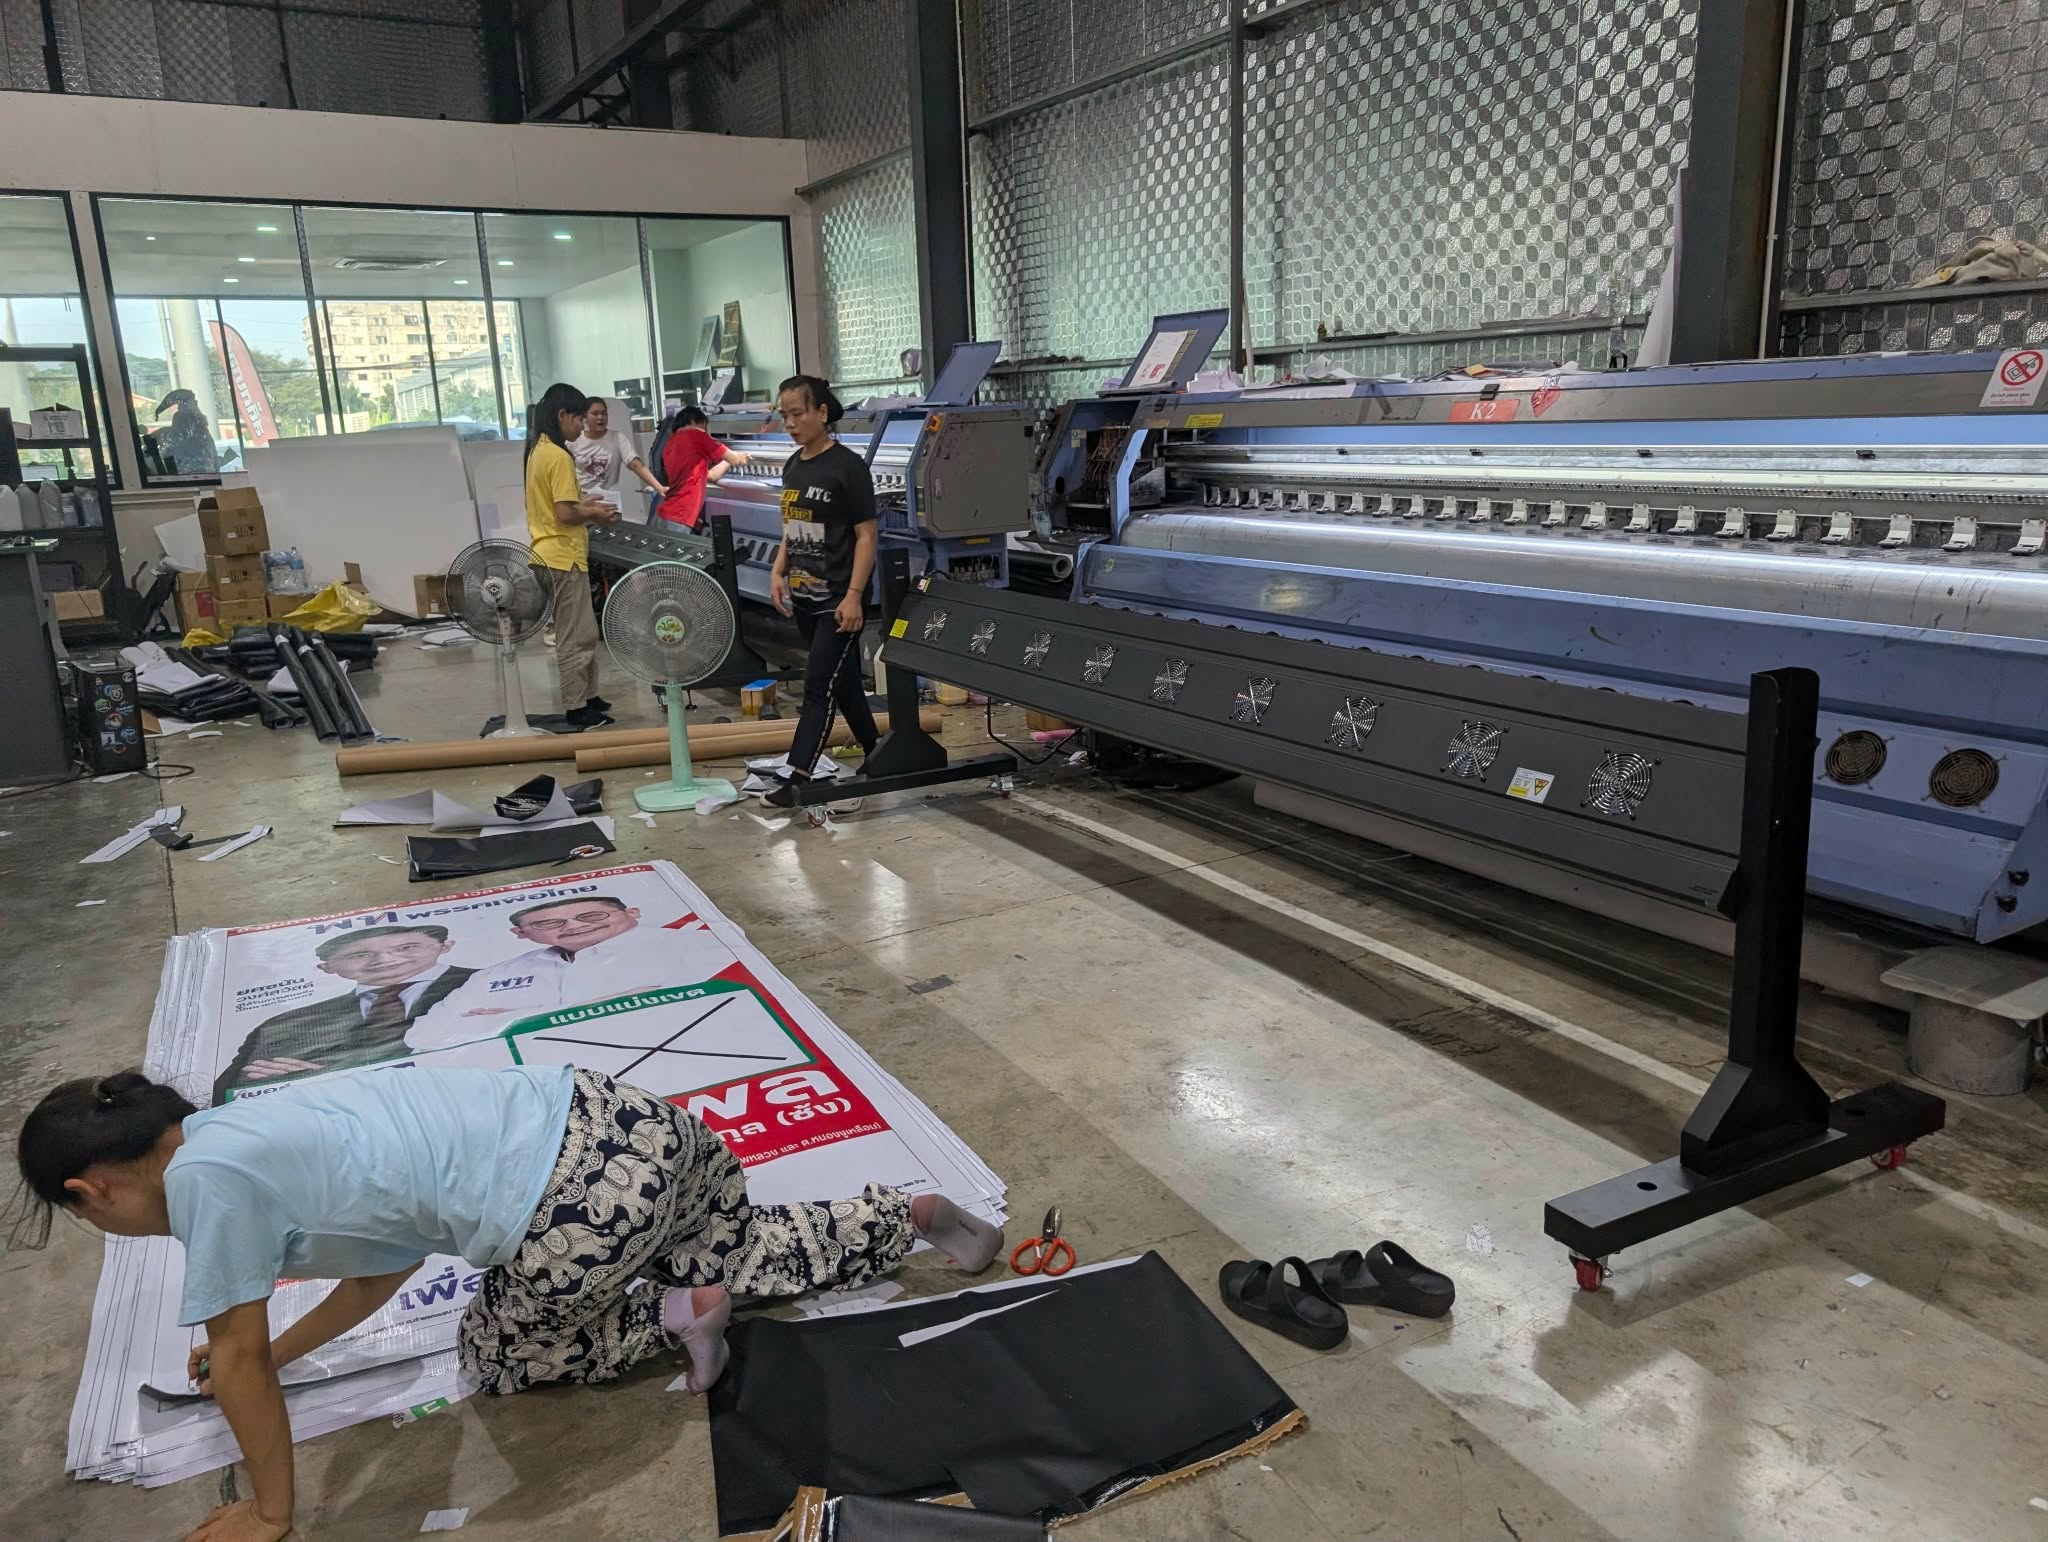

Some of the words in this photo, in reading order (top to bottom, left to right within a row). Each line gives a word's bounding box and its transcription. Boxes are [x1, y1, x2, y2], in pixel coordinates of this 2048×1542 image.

[1468, 402, 1497, 420] K2
[805, 485, 832, 503] NYC
[580, 868, 623, 880] 17.00
[549, 988, 706, 1025] แบบแบ่งเขต
[687, 1070, 840, 1121] พล
[716, 1121, 768, 1144] กุล
[740, 1148, 778, 1164] พหลวง
[780, 1142, 800, 1154] และ
[400, 1265, 482, 1311] เพื่อ
